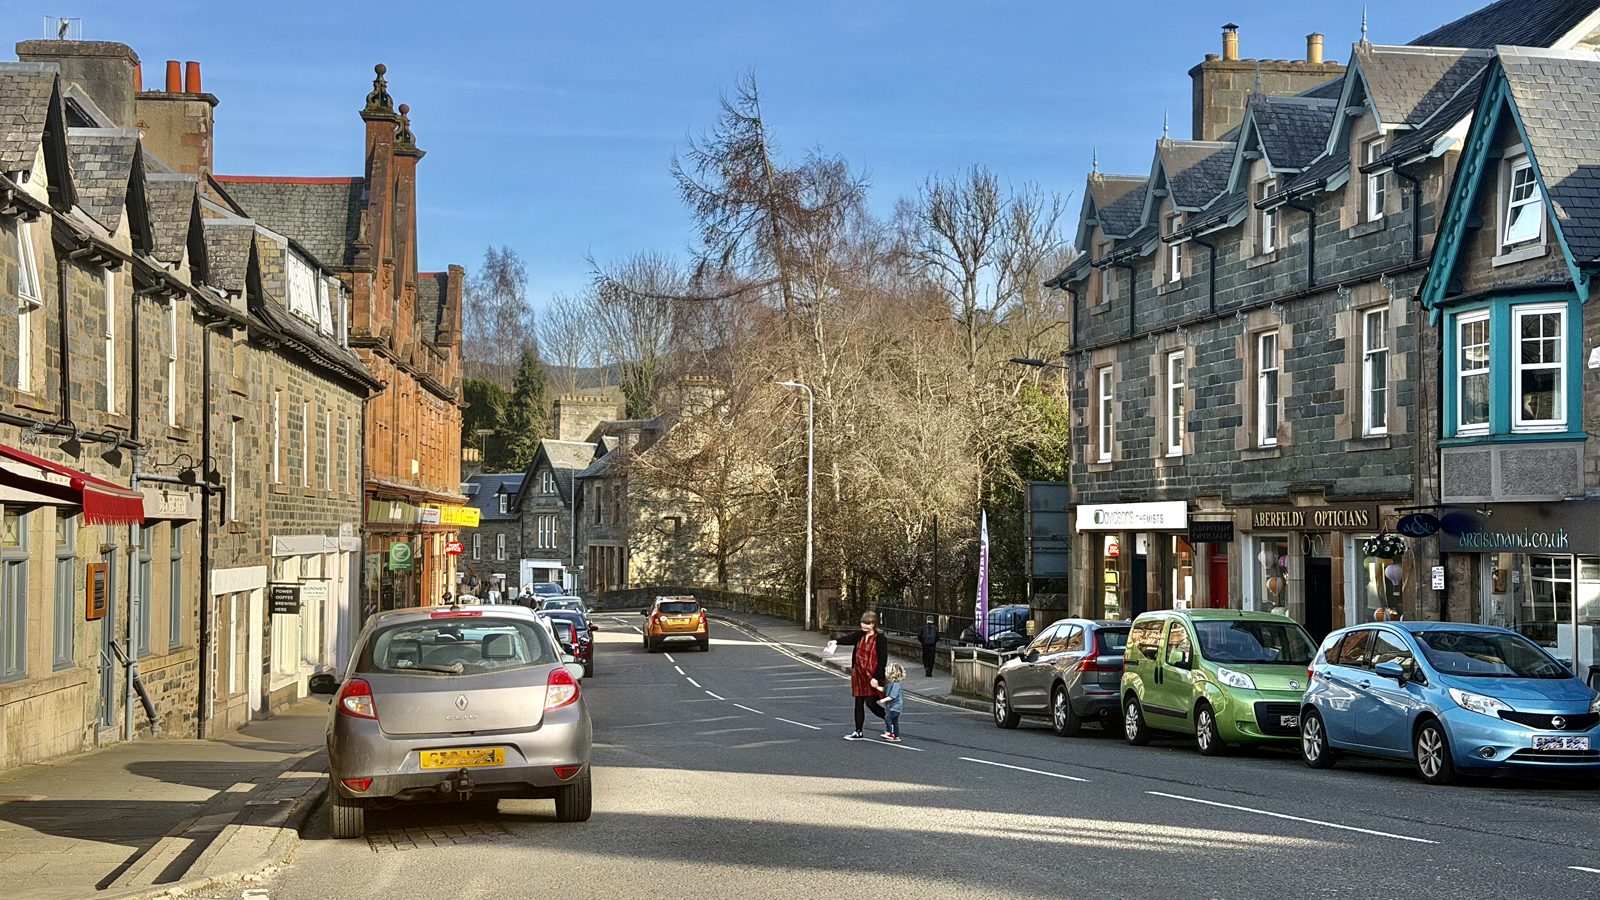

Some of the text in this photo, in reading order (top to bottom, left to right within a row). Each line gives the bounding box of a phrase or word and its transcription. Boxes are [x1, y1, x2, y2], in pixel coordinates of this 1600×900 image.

[1094, 509, 1164, 525] Davidsons CHEMISTS
[1254, 510, 1369, 527] ABERFELDY OPTICIANS
[1192, 532, 1232, 540] OPTICIANS
[1459, 526, 1569, 549] artisanand.co.uk
